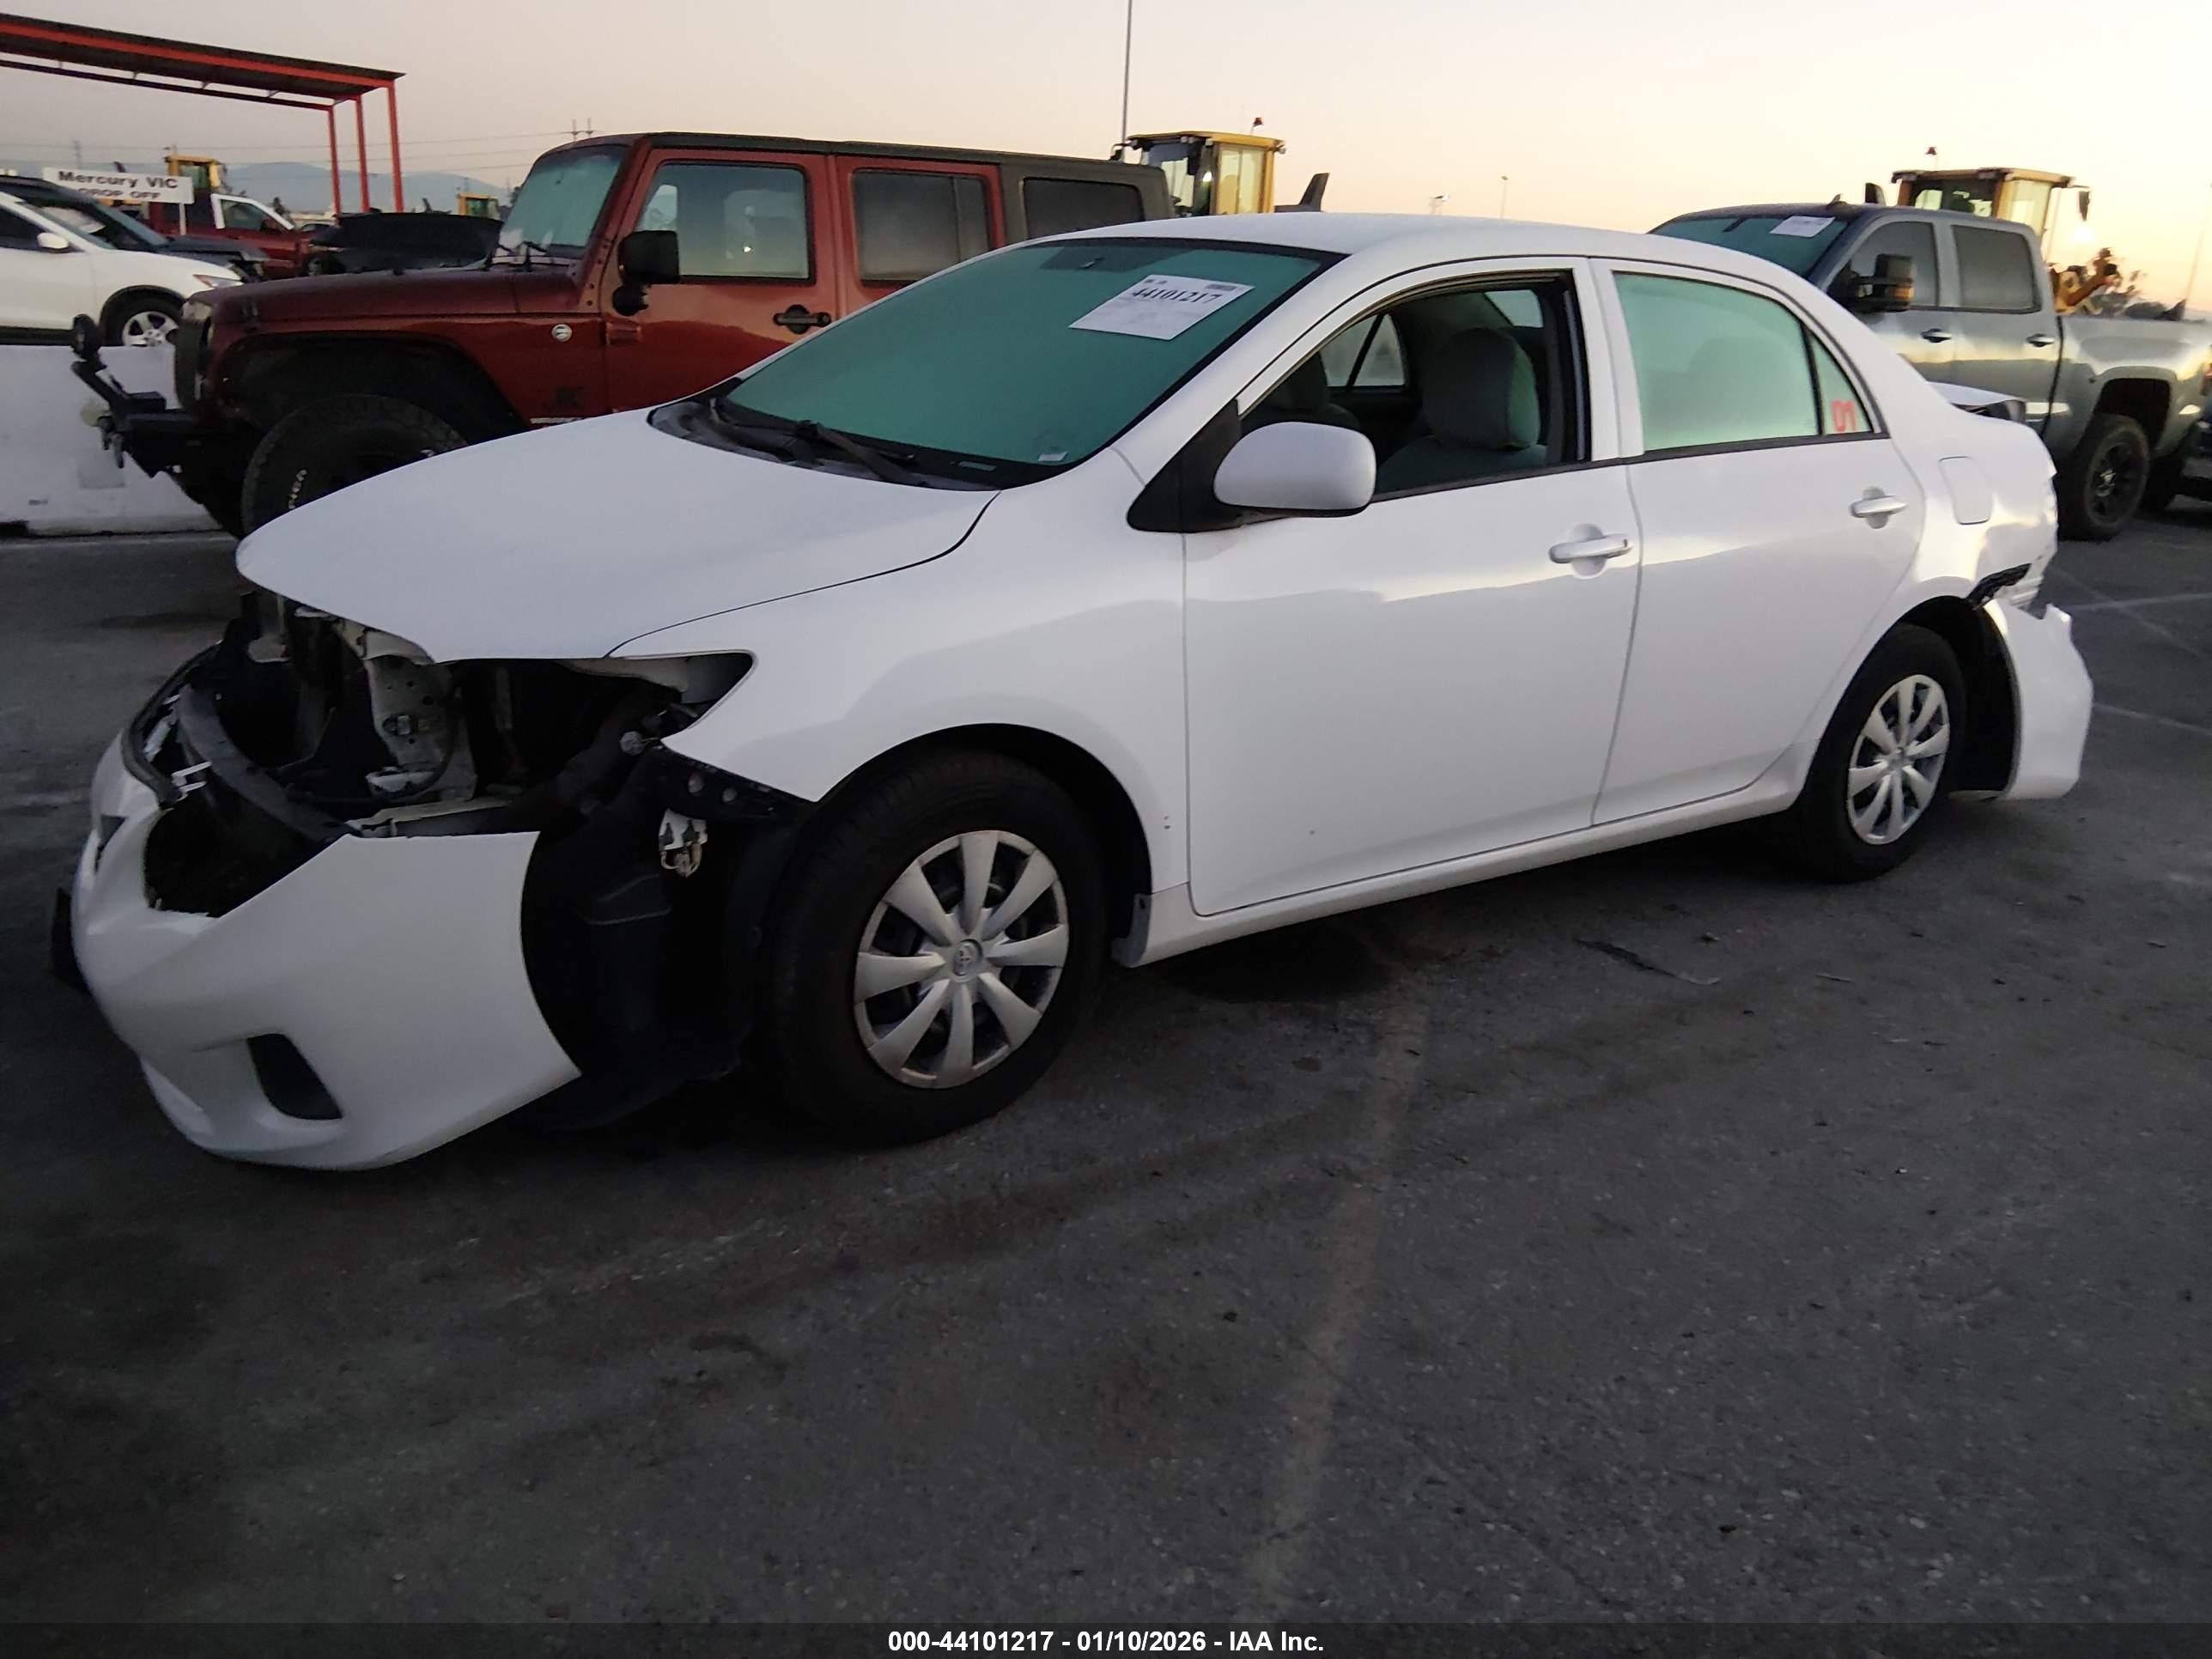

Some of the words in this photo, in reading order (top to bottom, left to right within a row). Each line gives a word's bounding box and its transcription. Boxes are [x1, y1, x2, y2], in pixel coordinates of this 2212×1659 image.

[58, 171, 138, 188] Mercury
[146, 176, 179, 189] VIC
[130, 191, 161, 199] OFF
[1132, 288, 1224, 304] 44101217
